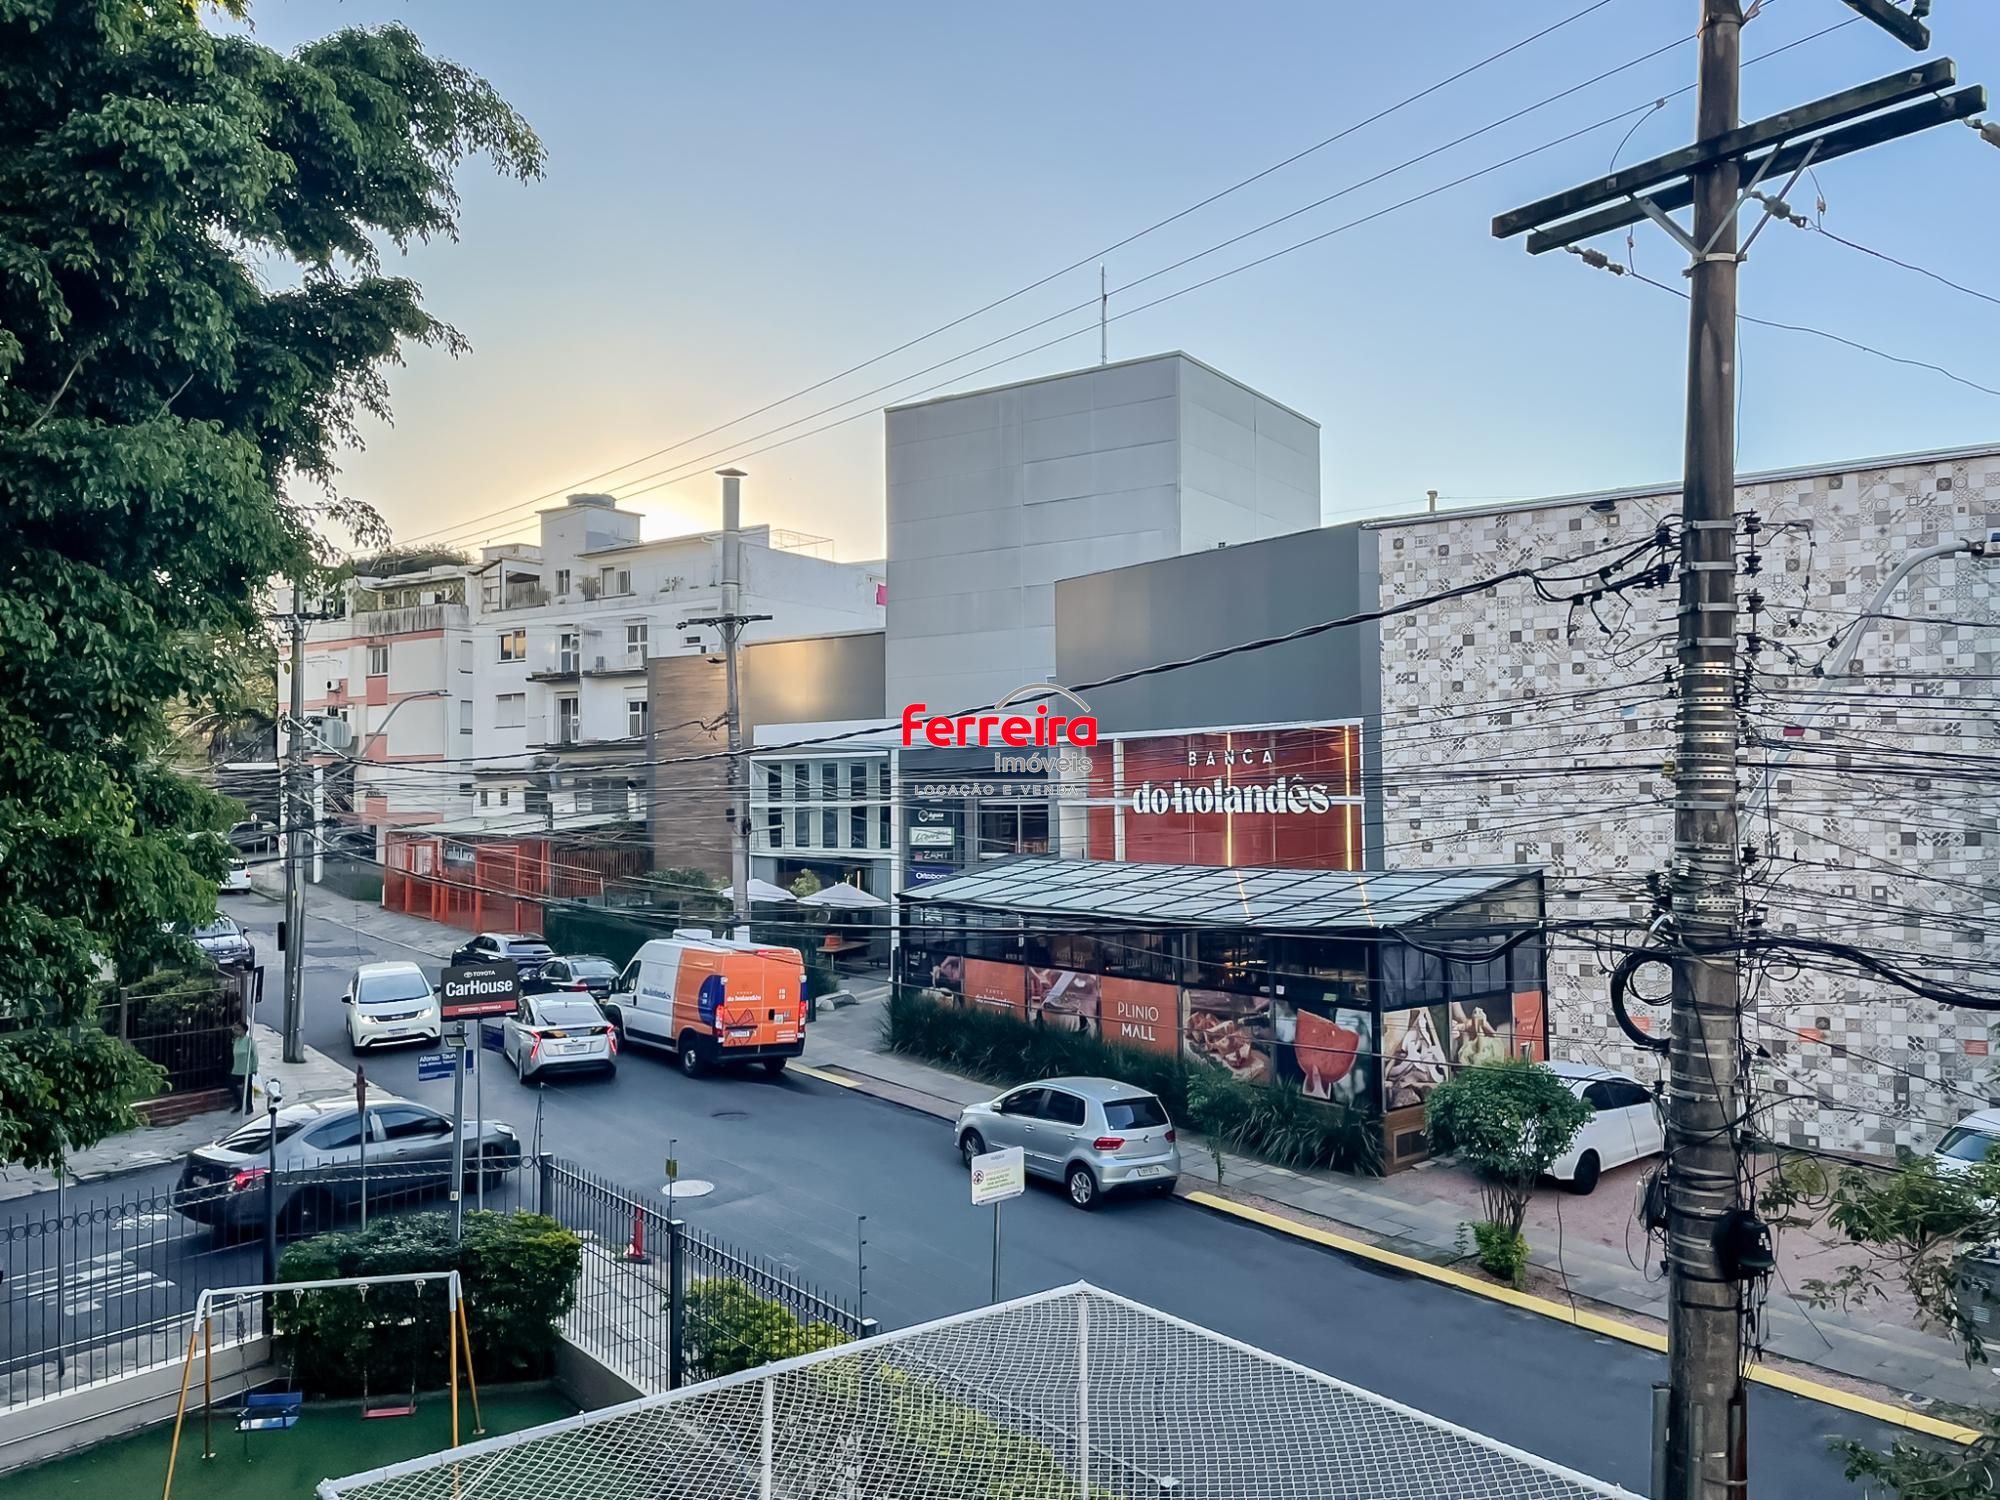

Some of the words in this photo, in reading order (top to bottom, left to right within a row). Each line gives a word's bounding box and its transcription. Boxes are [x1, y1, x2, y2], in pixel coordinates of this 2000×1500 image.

[1188, 748, 1273, 766] BANCA
[1132, 780, 1169, 814] do
[445, 980, 513, 997] CarHouse
[1118, 1001, 1159, 1022] PLINIO
[1121, 1022, 1157, 1041] MALL
